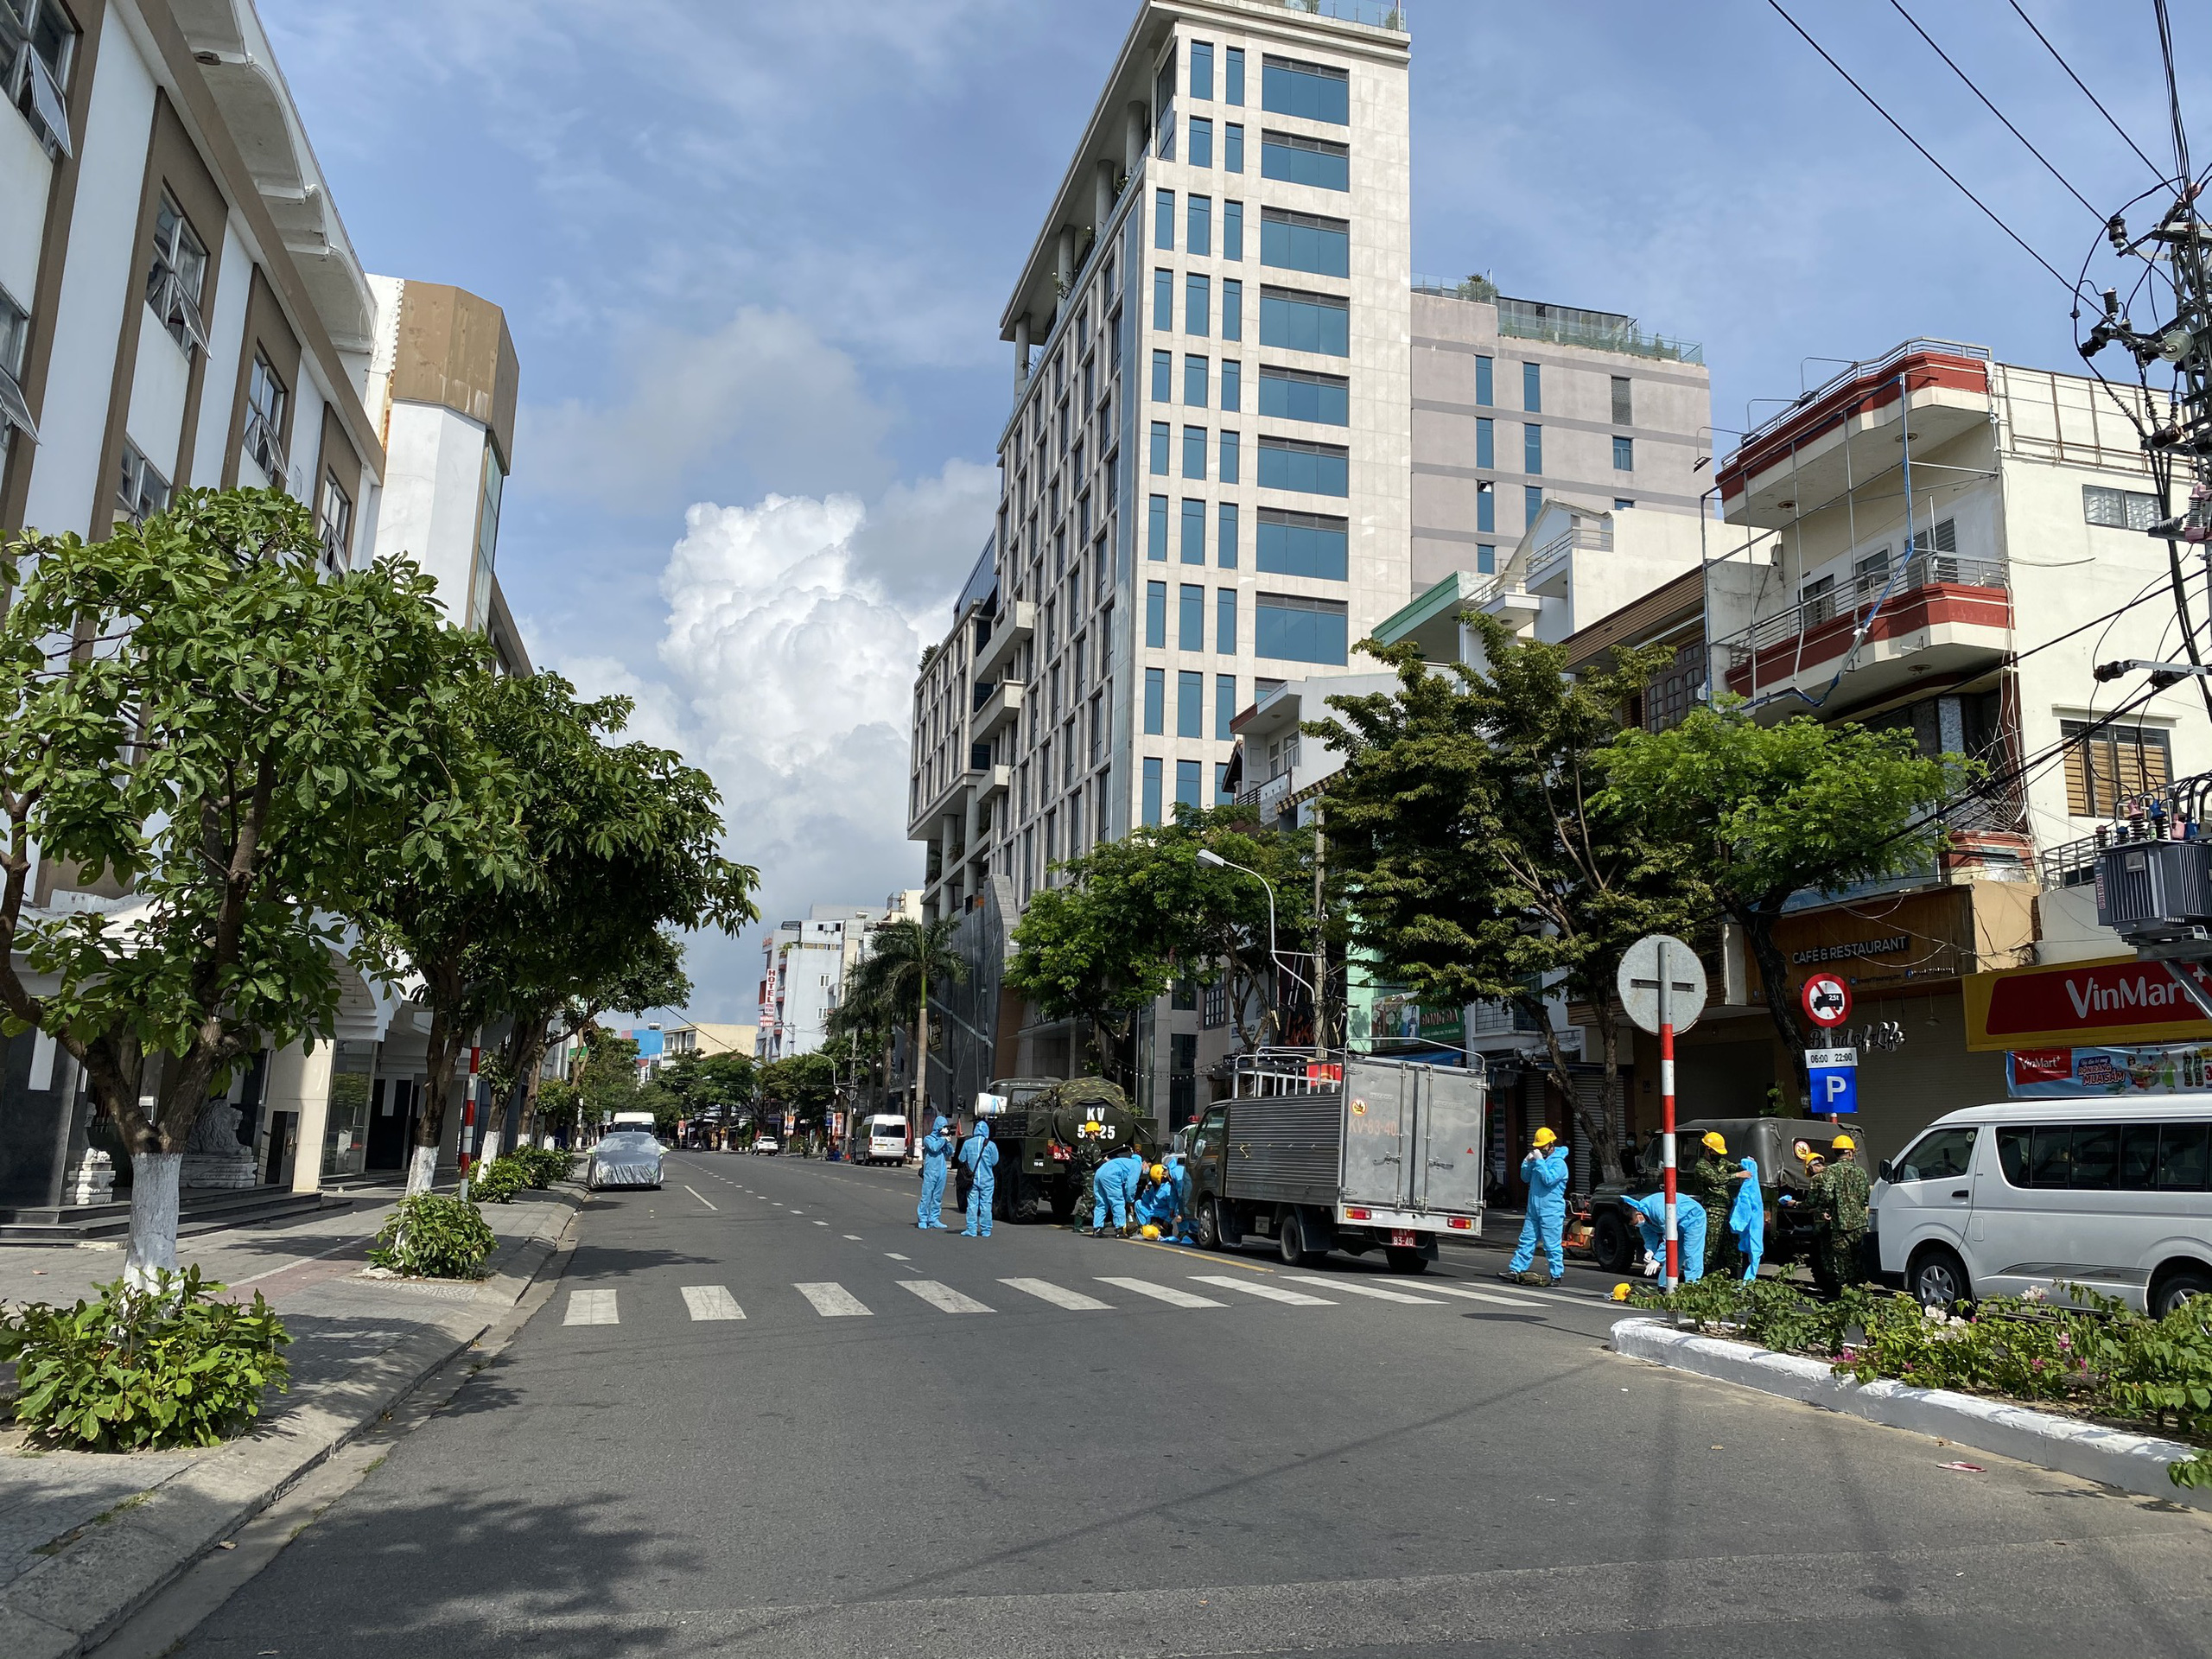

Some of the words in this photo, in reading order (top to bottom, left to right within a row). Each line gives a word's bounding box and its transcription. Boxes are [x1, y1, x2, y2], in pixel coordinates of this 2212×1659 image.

[1792, 947, 1819, 964] CAFÉ
[1821, 949, 1828, 960] &
[1831, 936, 1906, 958] RESTAURANT
[767, 970, 776, 1002] HOTEL
[1872, 1021, 1906, 1052] Life
[1811, 1054, 1828, 1064] 06:00
[1835, 1052, 1853, 1063] 22:00
[1826, 1075, 1847, 1103] P
[1086, 1107, 1105, 1122] KV
[1349, 1117, 1396, 1136] KV-83-40
[1393, 1236, 1414, 1246] 83-40
